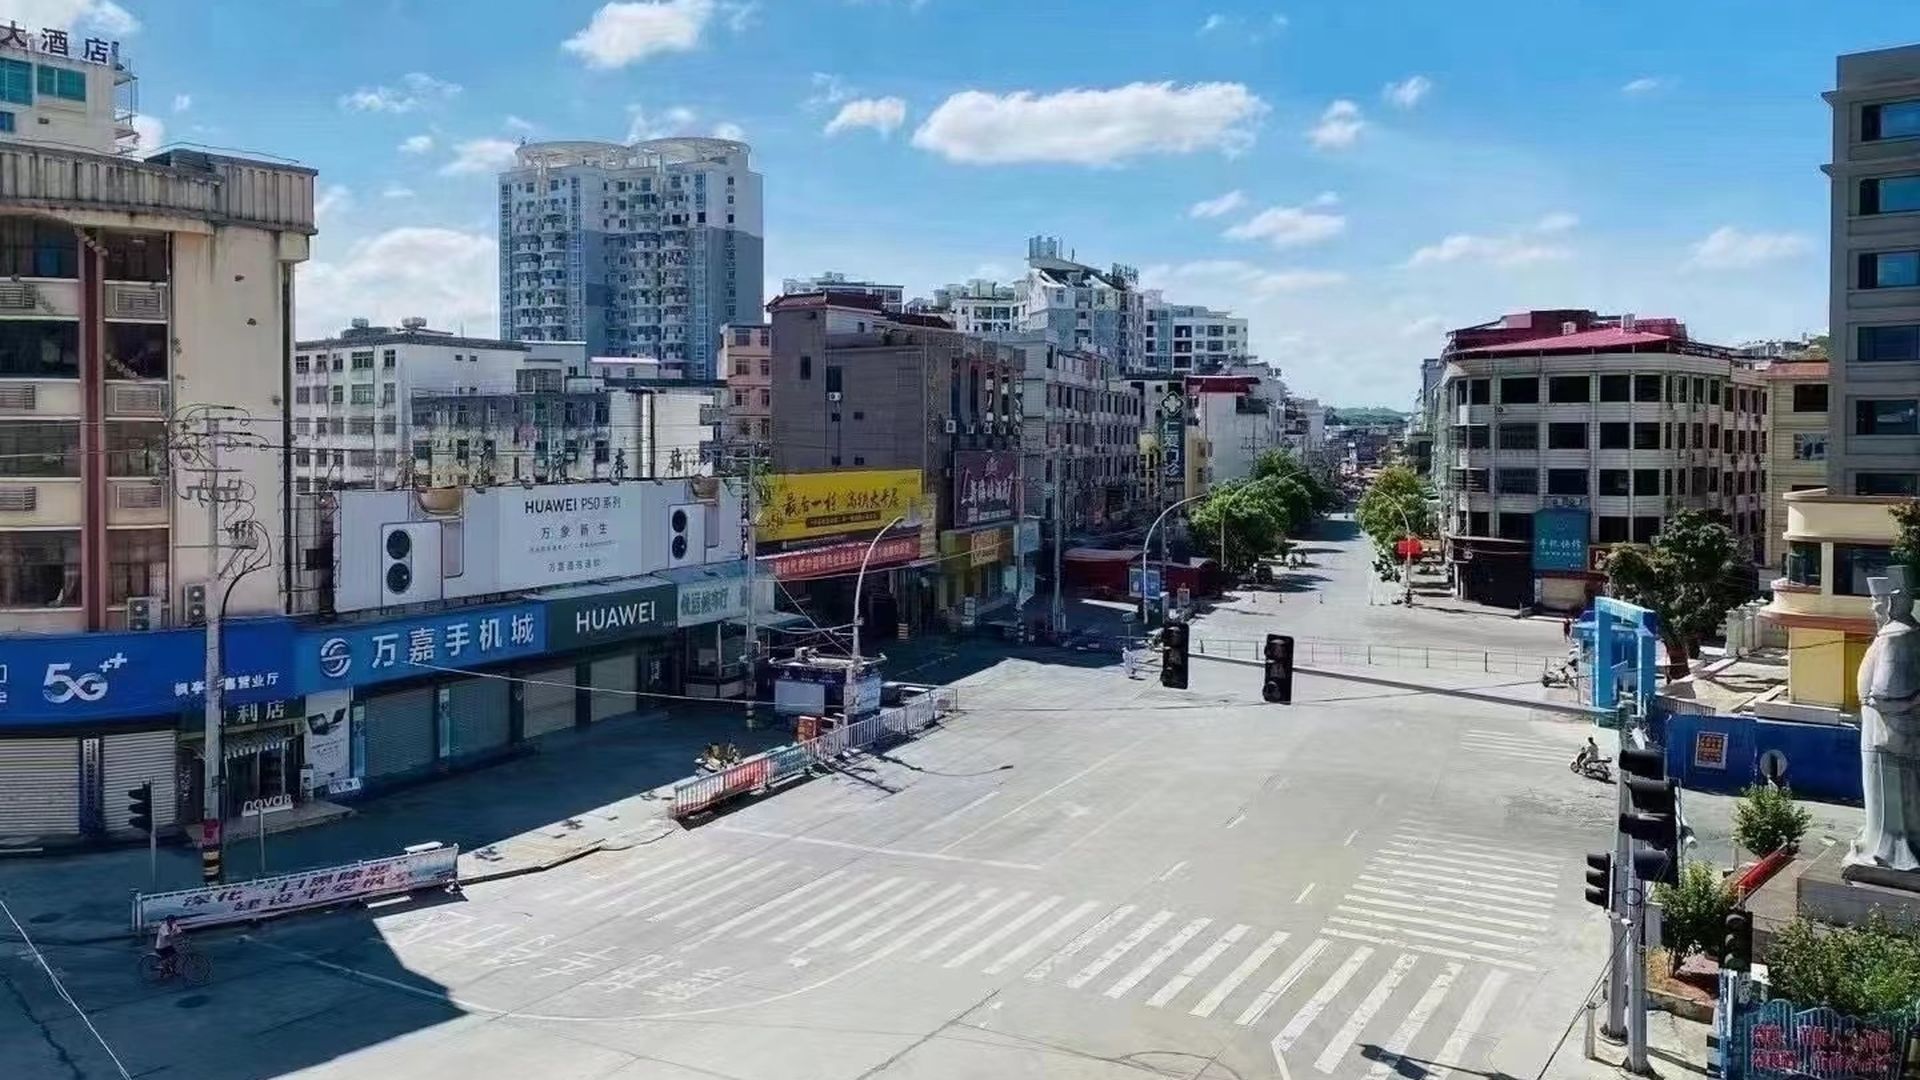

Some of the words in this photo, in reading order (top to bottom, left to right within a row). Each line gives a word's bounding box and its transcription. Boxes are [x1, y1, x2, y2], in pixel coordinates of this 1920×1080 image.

[0, 20, 109, 65] 大酒店
[525, 498, 577, 514] HUAWEI
[581, 497, 601, 511] P50
[603, 496, 622, 509] 系列
[540, 523, 608, 540] 万象新生
[576, 601, 656, 634] HUAWEI
[371, 614, 535, 669] 万嘉手机城
